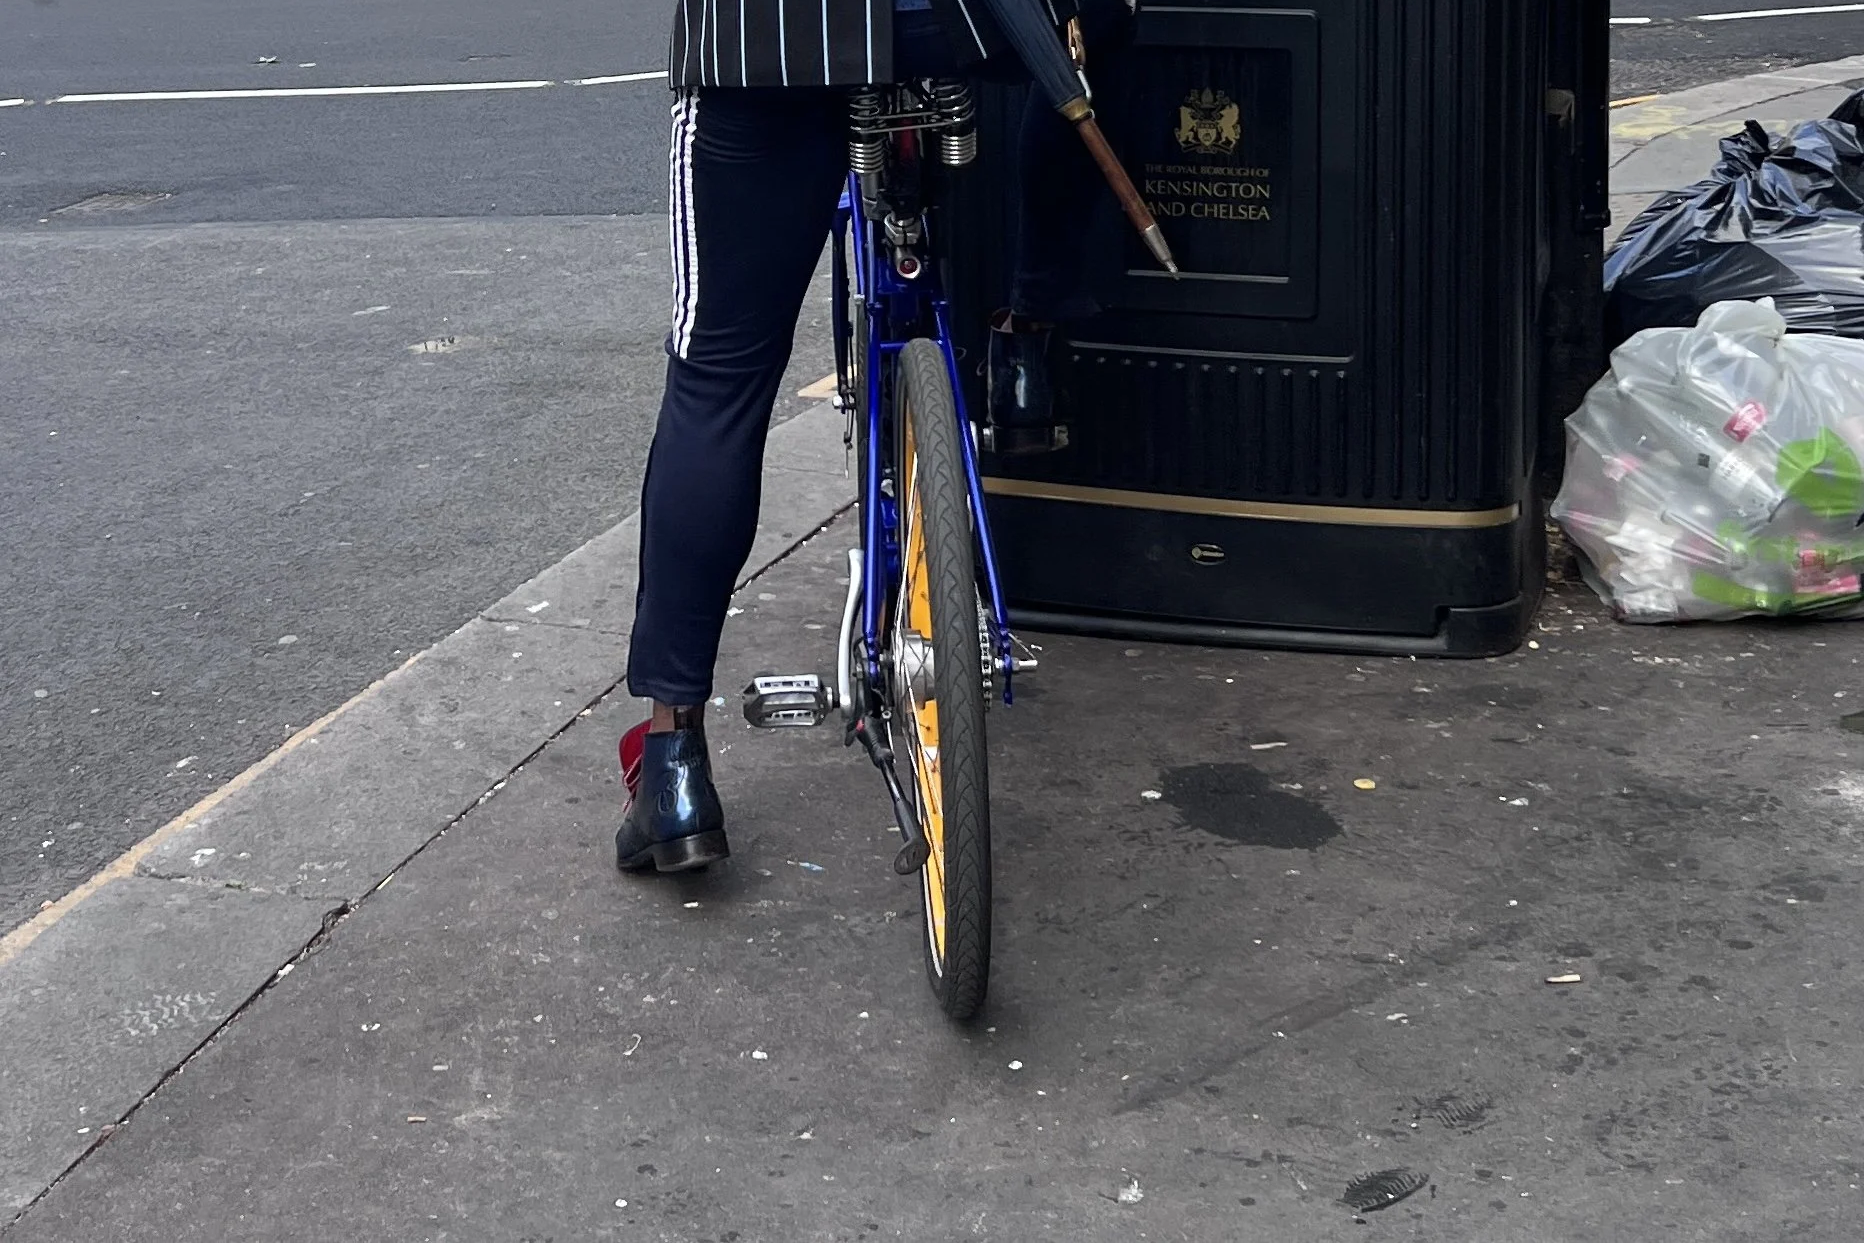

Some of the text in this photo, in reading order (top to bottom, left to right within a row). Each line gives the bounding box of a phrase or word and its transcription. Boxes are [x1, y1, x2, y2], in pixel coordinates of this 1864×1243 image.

[1145, 179, 1270, 199] KENSINGTON
[1146, 201, 1271, 221] AND CHELSEA
